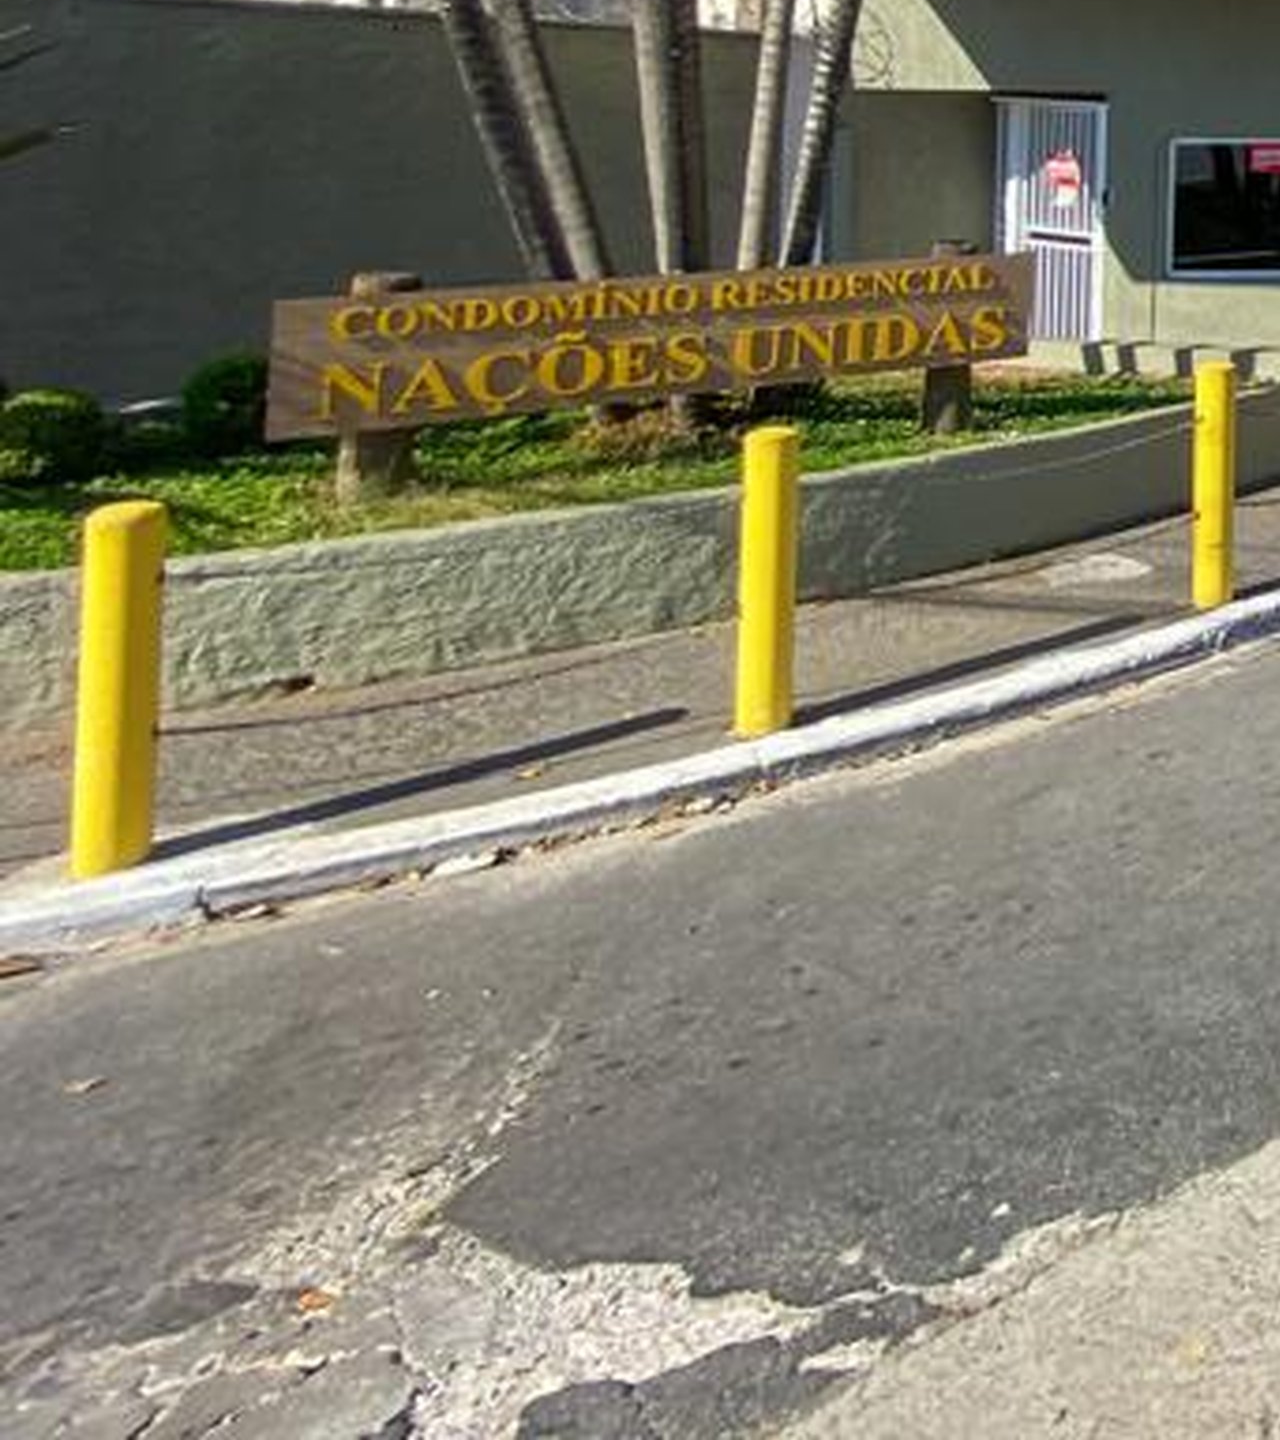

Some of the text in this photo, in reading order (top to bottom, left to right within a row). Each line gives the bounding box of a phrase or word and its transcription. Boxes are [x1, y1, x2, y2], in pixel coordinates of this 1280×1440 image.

[711, 262, 995, 310] RESIDENCIAL
[317, 306, 1007, 418] NAÇÕES UNIDAS
